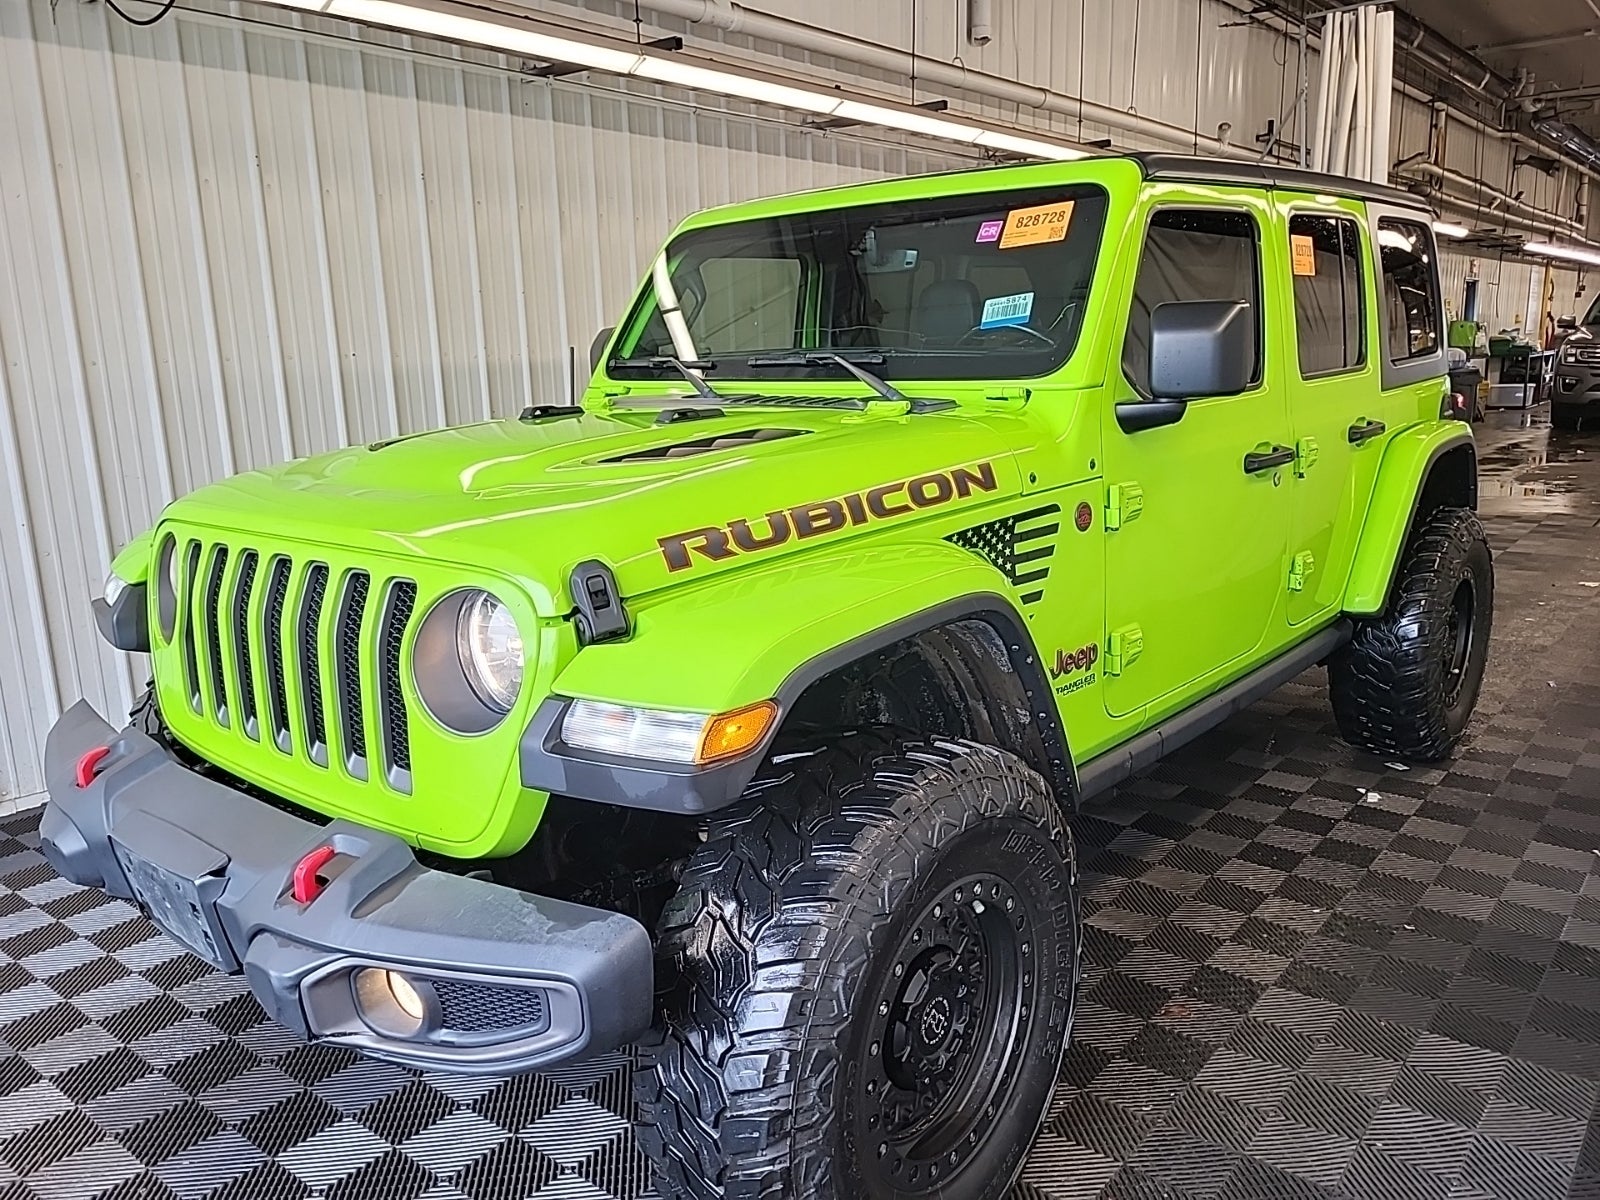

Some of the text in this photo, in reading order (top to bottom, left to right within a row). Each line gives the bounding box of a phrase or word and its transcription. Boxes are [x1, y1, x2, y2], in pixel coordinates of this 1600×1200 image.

[981, 226, 998, 237] CR
[1015, 210, 1066, 229] 828728
[657, 462, 998, 573] RUBICON
[1049, 643, 1098, 680] Jeep
